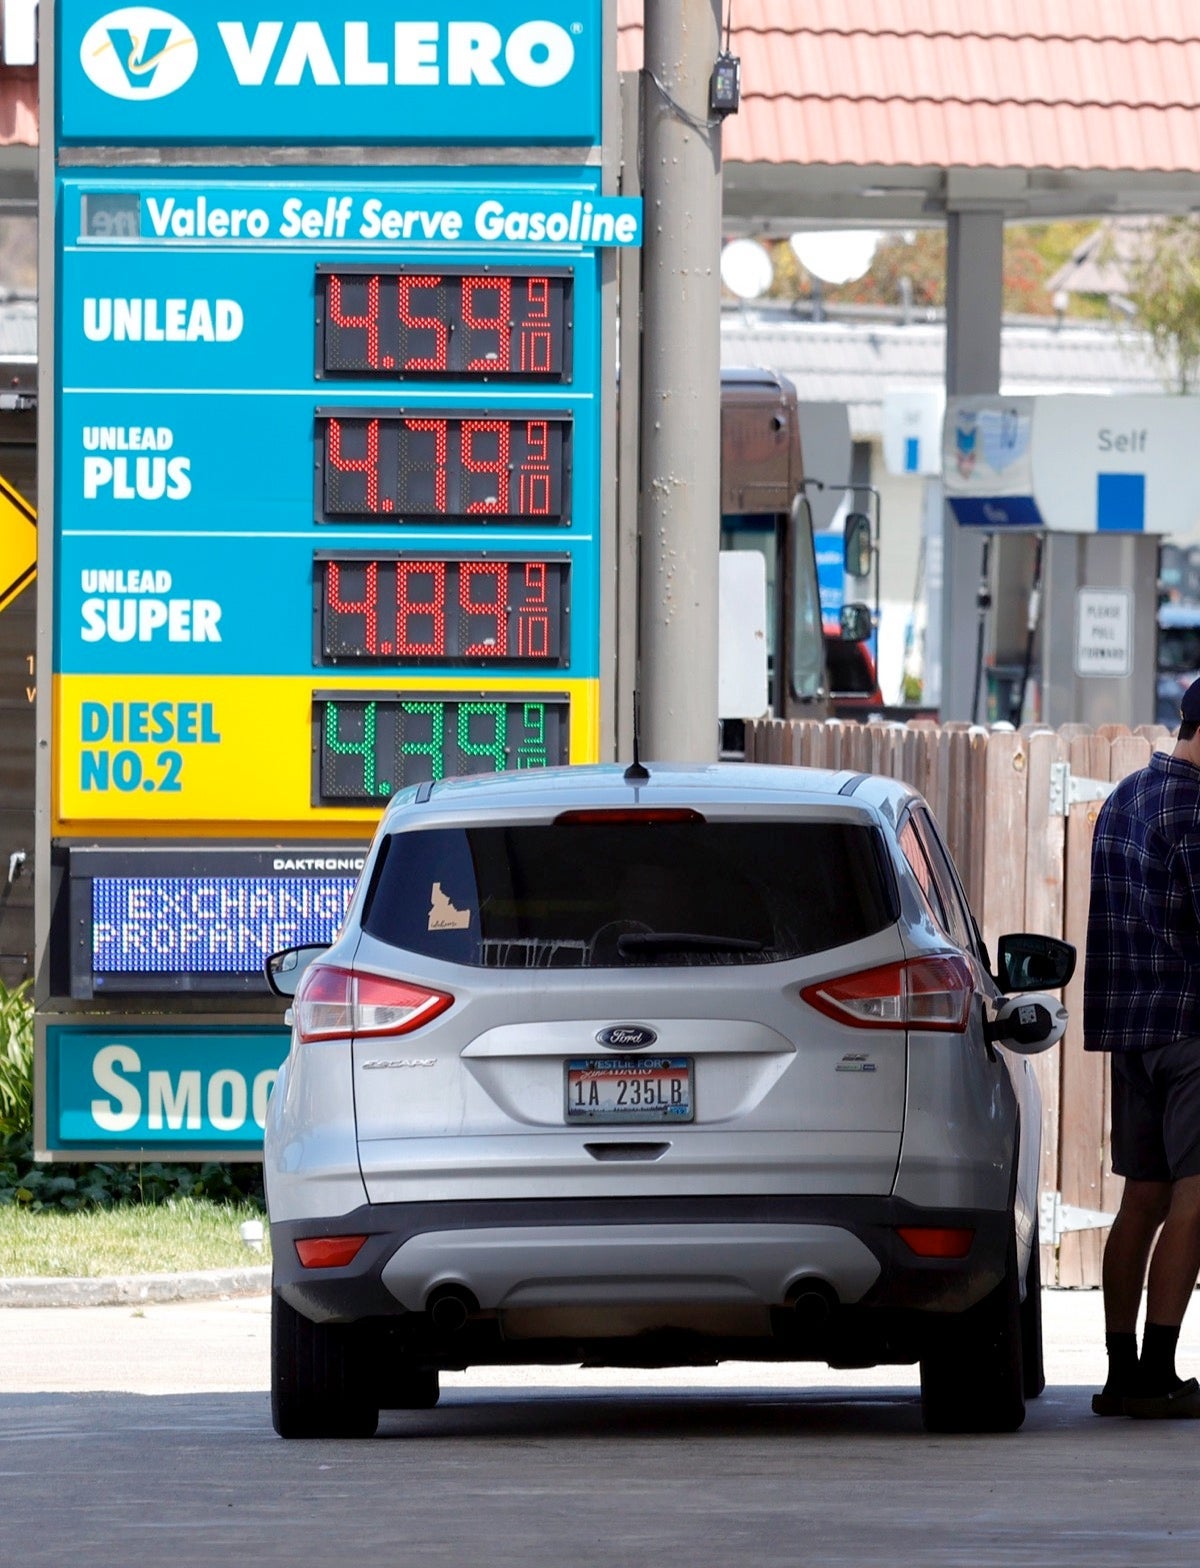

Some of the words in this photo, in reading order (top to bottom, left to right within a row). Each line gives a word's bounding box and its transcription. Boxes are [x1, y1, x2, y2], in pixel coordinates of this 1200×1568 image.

[217, 20, 576, 88] VALERO
[146, 196, 269, 238] Valero
[279, 198, 351, 238] Self
[360, 202, 464, 240] Serve
[474, 201, 638, 243] Gasoline
[83, 298, 244, 343] UNLEAD
[330, 274, 511, 372] 4.59
[82, 426, 173, 451] UNLEAD
[1097, 428, 1149, 454] Self
[83, 456, 192, 499] PLUS
[328, 417, 510, 514] 4.79
[81, 569, 172, 594] UNLEAD
[81, 598, 222, 643] SUPER
[327, 560, 507, 656] 4.89
[80, 701, 221, 744] DIESEL
[80, 750, 182, 792] NO.2
[93, 921, 297, 954] PROPANE
[609, 1028, 643, 1044] Ford
[575, 1080, 600, 1106] 1A
[617, 1079, 683, 1105] 235LB
